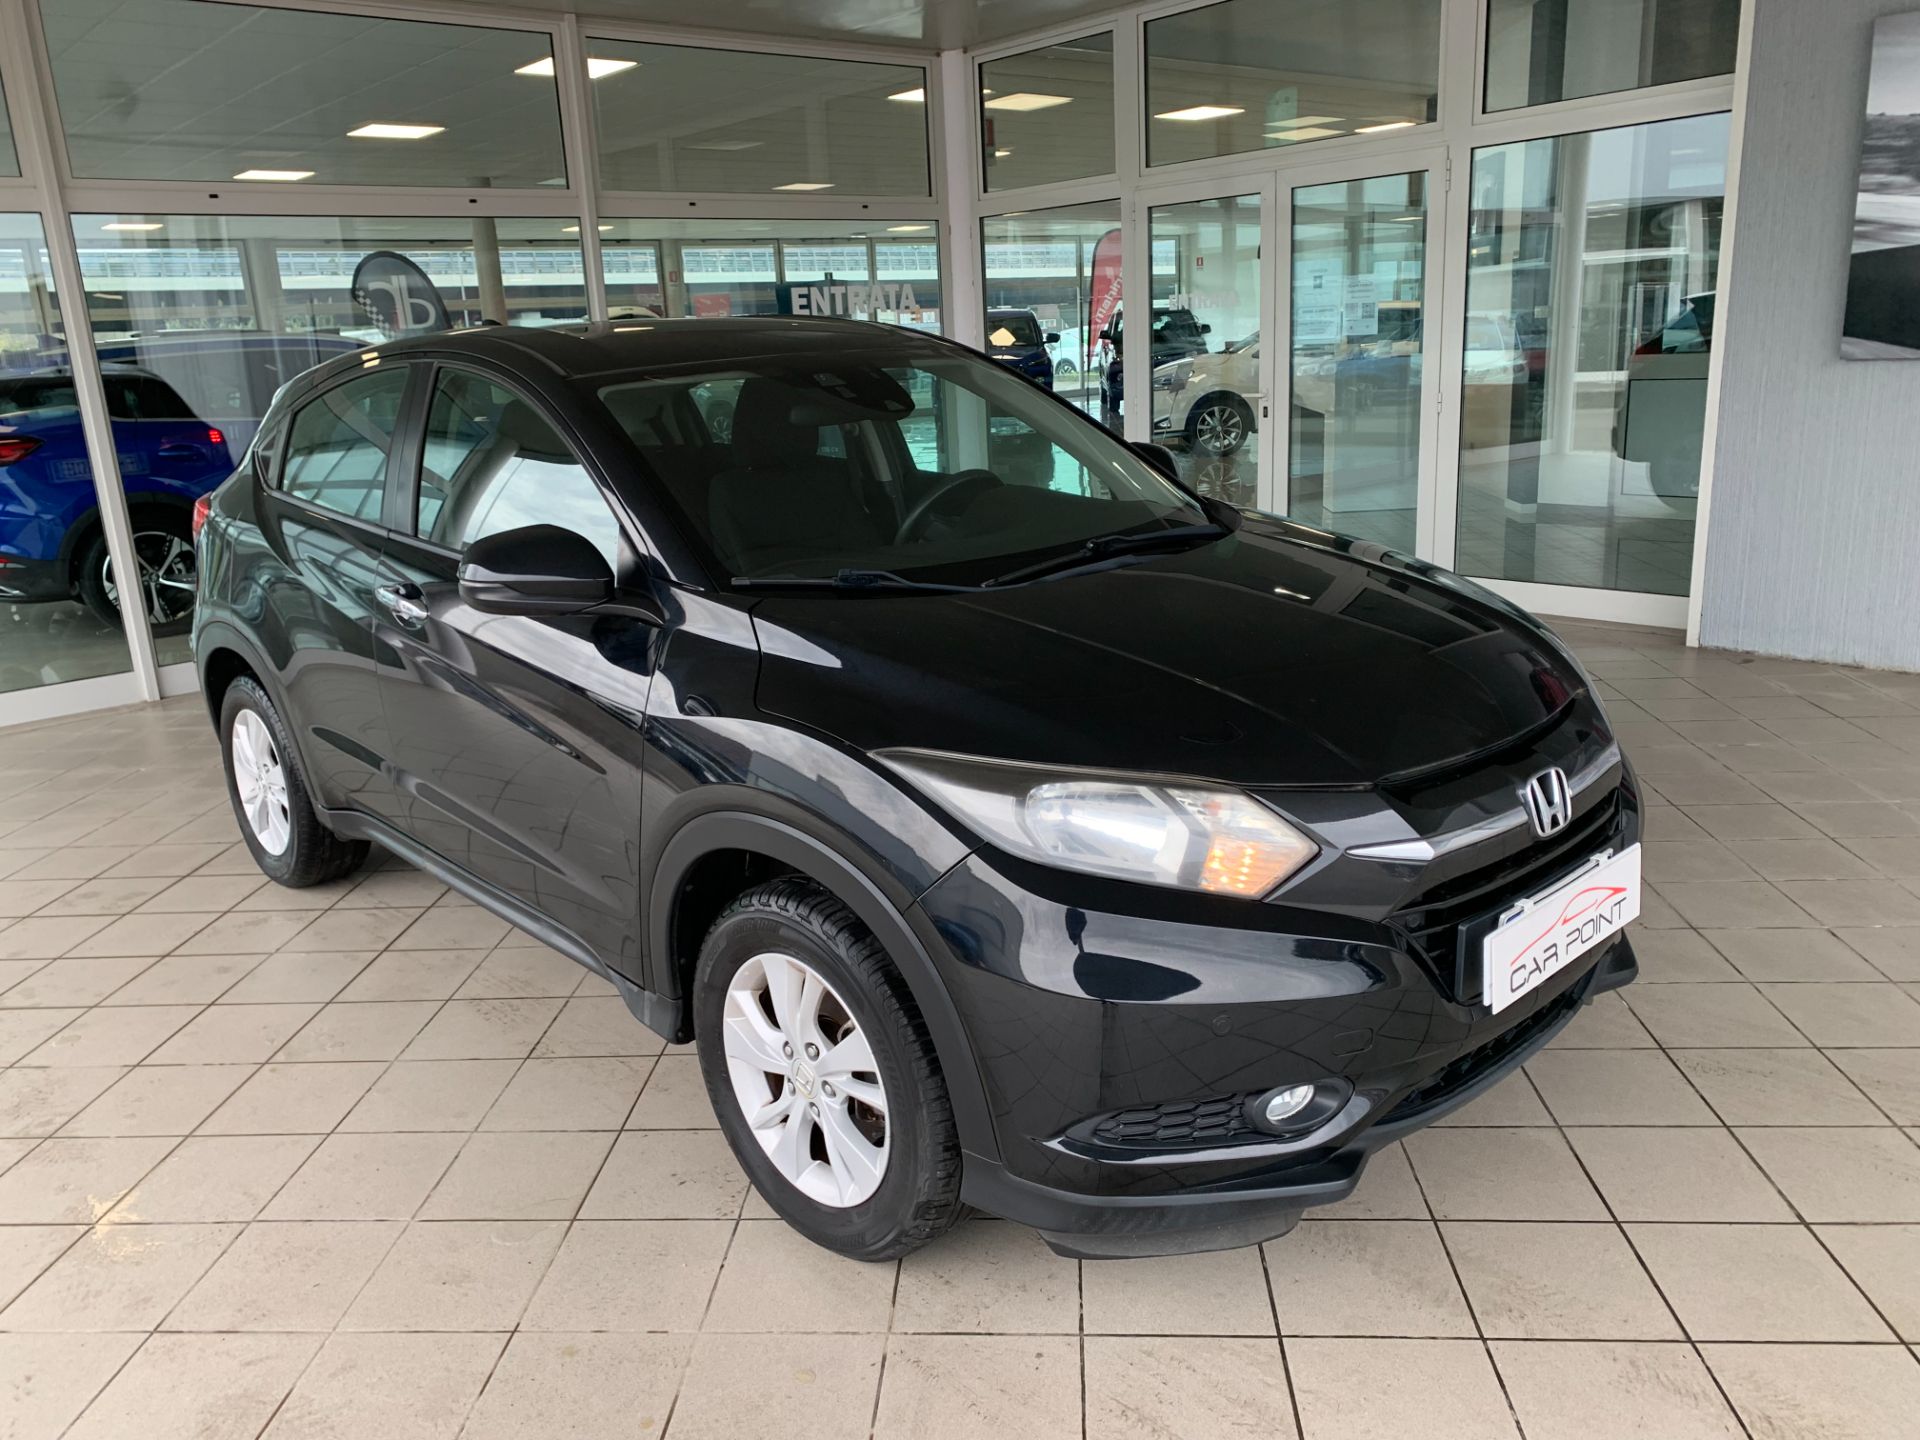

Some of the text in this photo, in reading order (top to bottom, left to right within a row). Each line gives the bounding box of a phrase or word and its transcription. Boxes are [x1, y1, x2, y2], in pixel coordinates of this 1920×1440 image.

[790, 284, 917, 316] ENTRATA
[1510, 897, 1627, 993] CAR POINT
